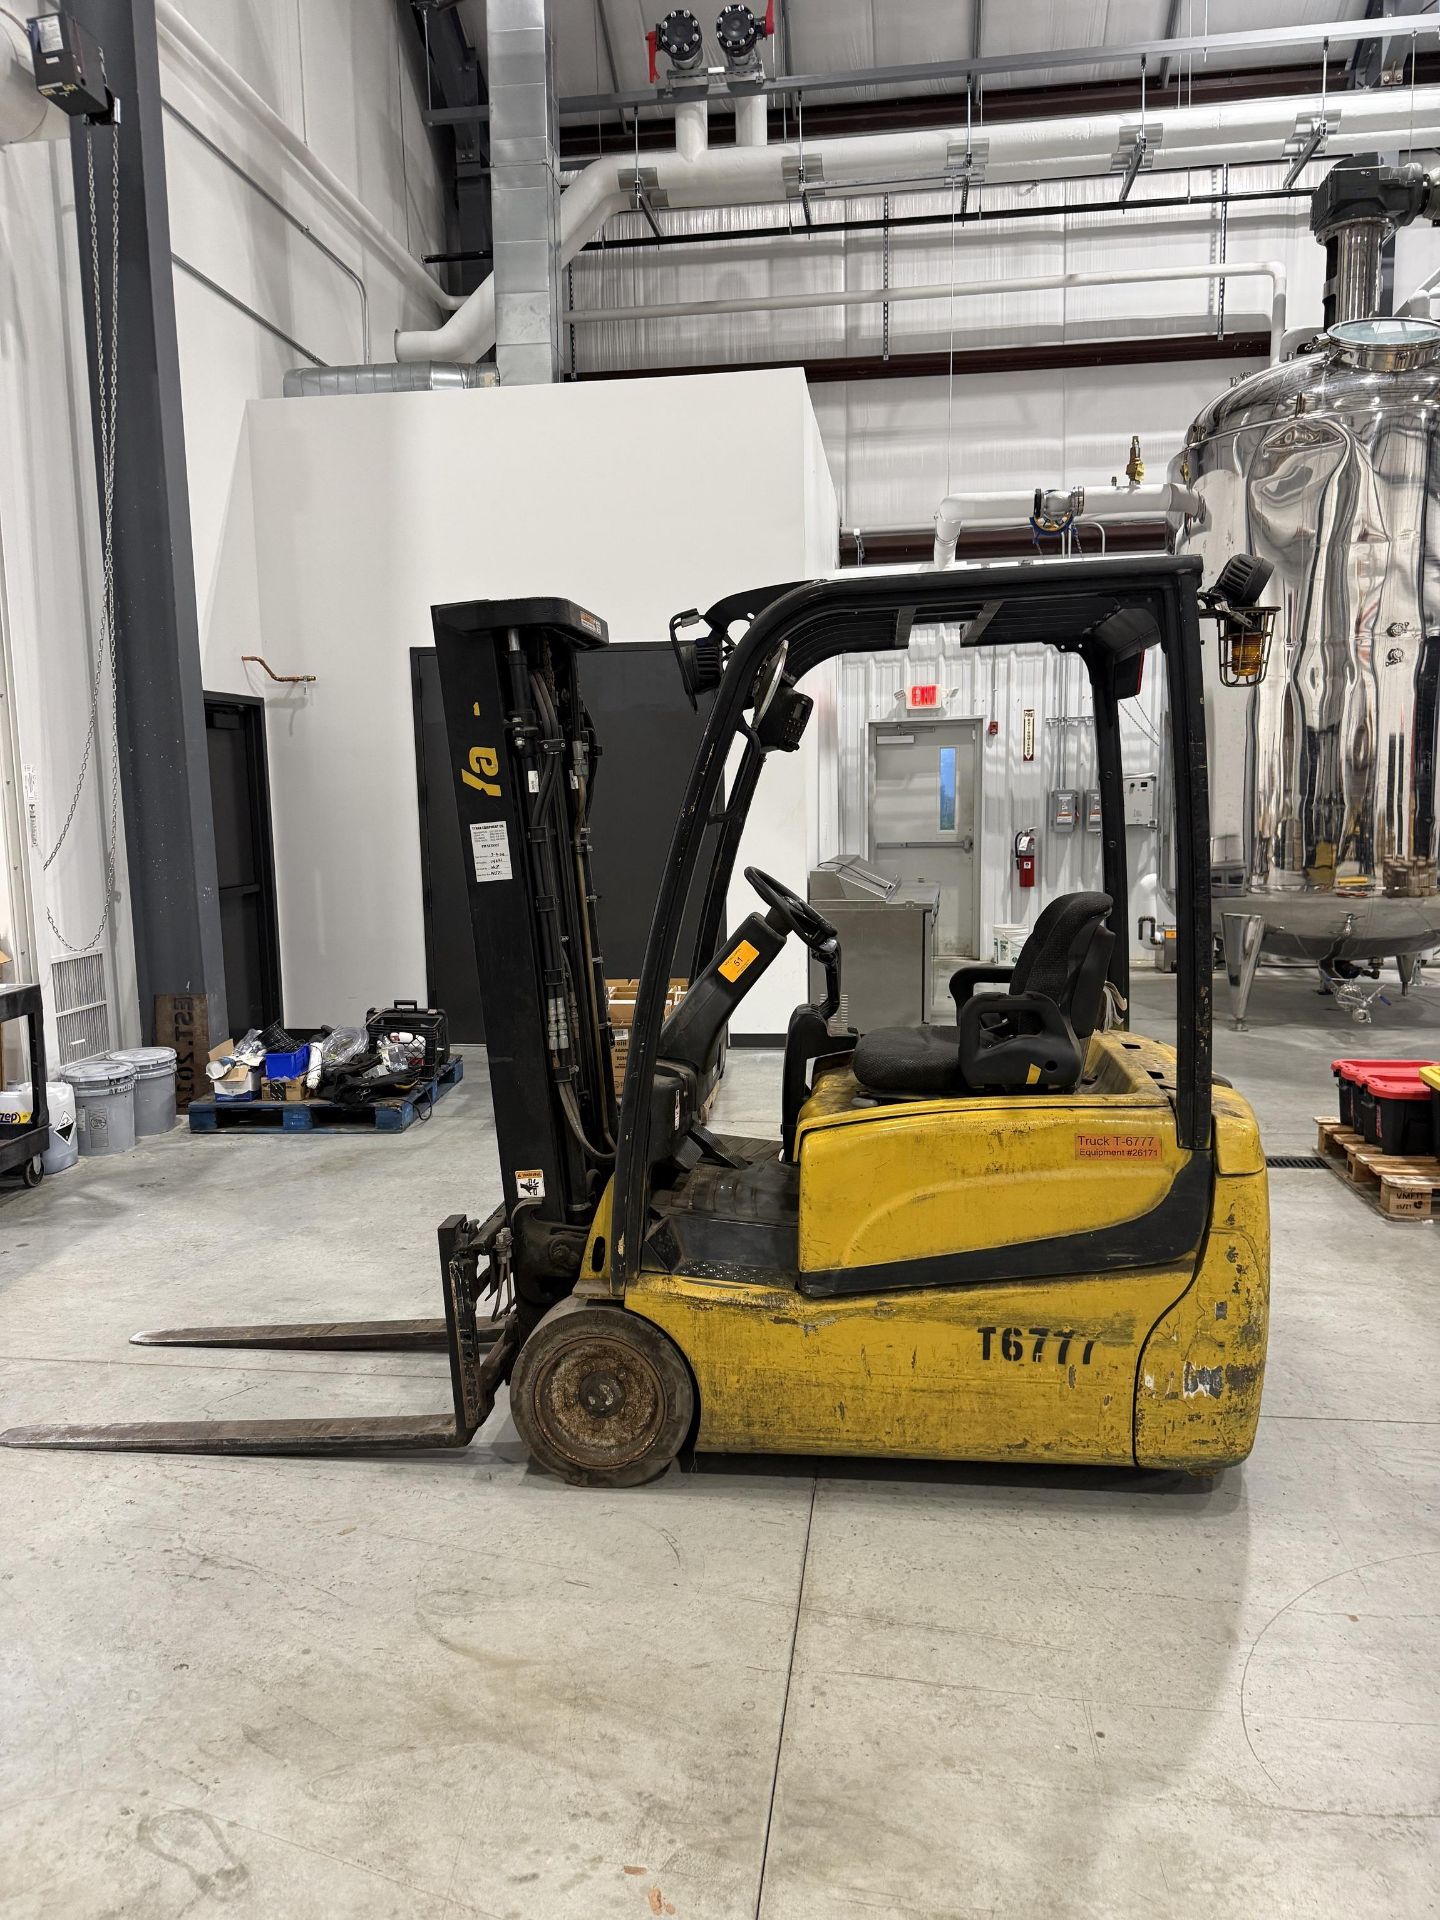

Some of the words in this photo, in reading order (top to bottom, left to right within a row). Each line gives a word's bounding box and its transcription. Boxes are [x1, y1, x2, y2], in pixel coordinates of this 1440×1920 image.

[1077, 1135, 1110, 1146] Truck
[1113, 1136, 1154, 1146] T-6777
[1080, 1149, 1125, 1158] Equipment
[1127, 1148, 1158, 1157] #26171
